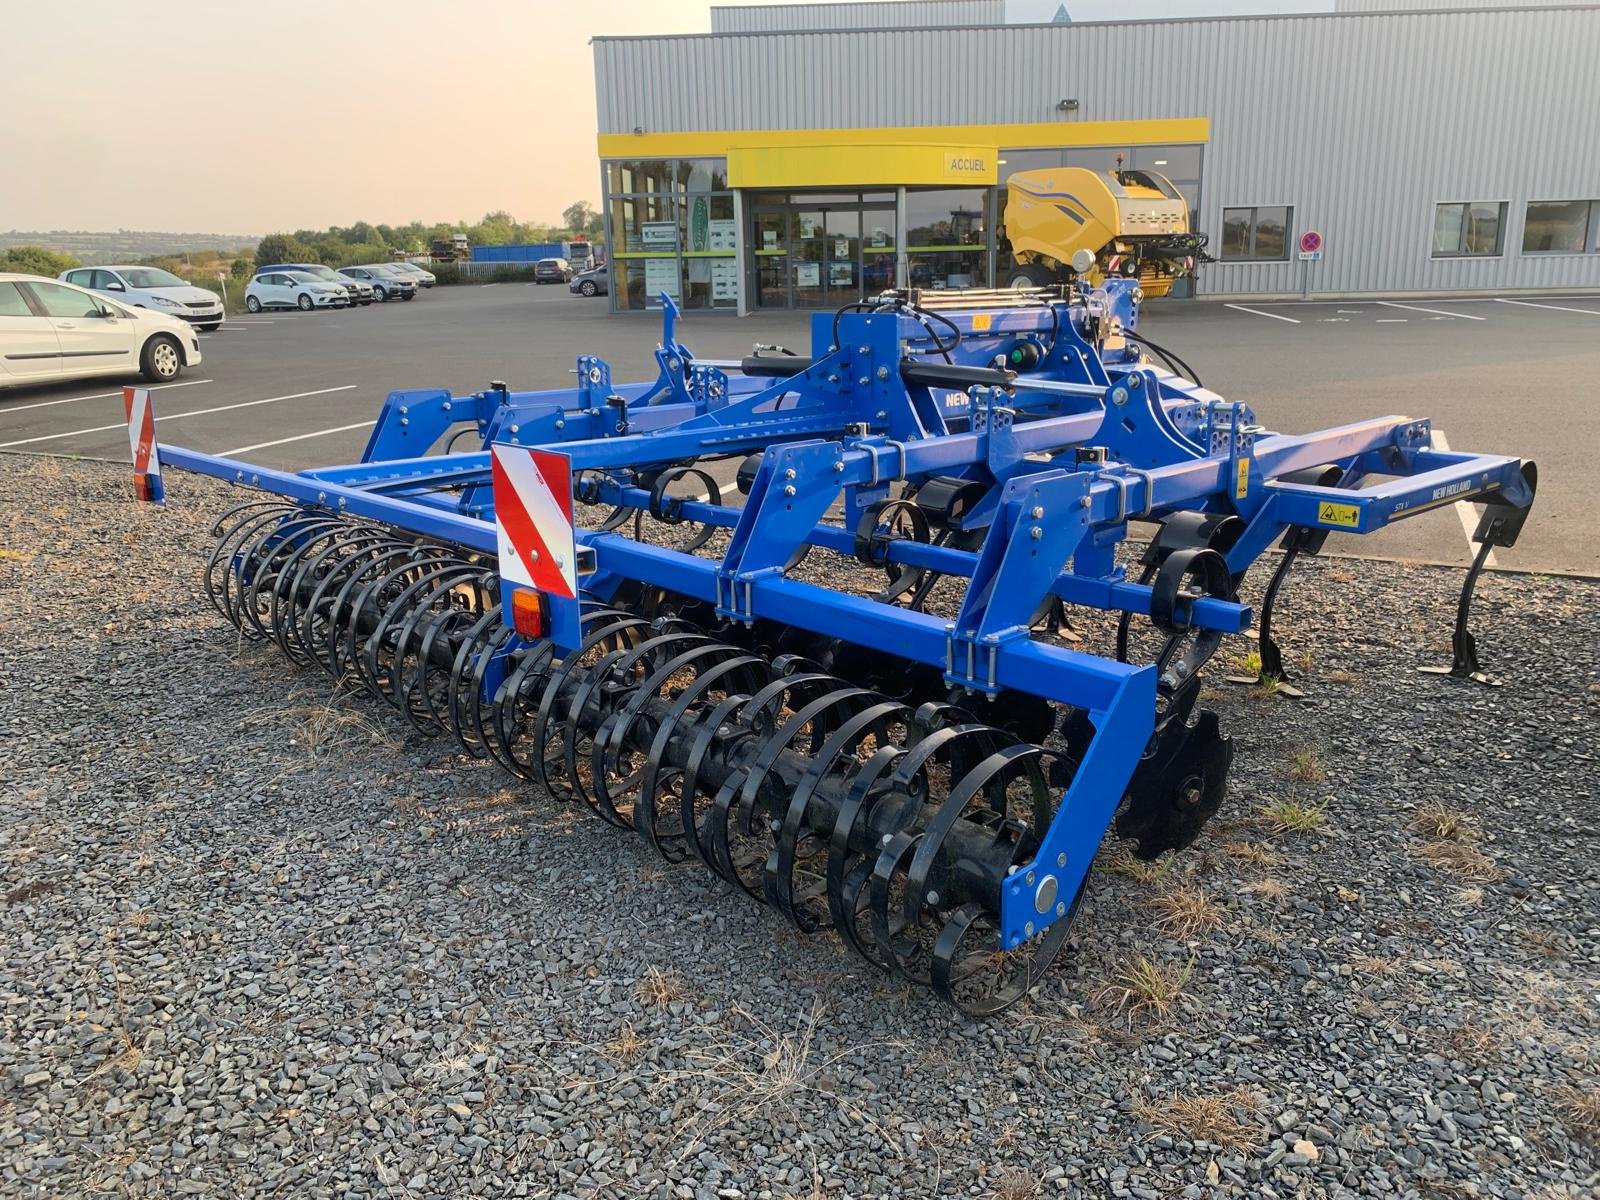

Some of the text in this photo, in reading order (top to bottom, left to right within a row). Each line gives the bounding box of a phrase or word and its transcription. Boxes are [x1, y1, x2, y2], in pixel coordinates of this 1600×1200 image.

[951, 159, 985, 171] ACCUEIL
[946, 392, 970, 407] NEW
[1432, 479, 1471, 500] NEW HOLLAND
